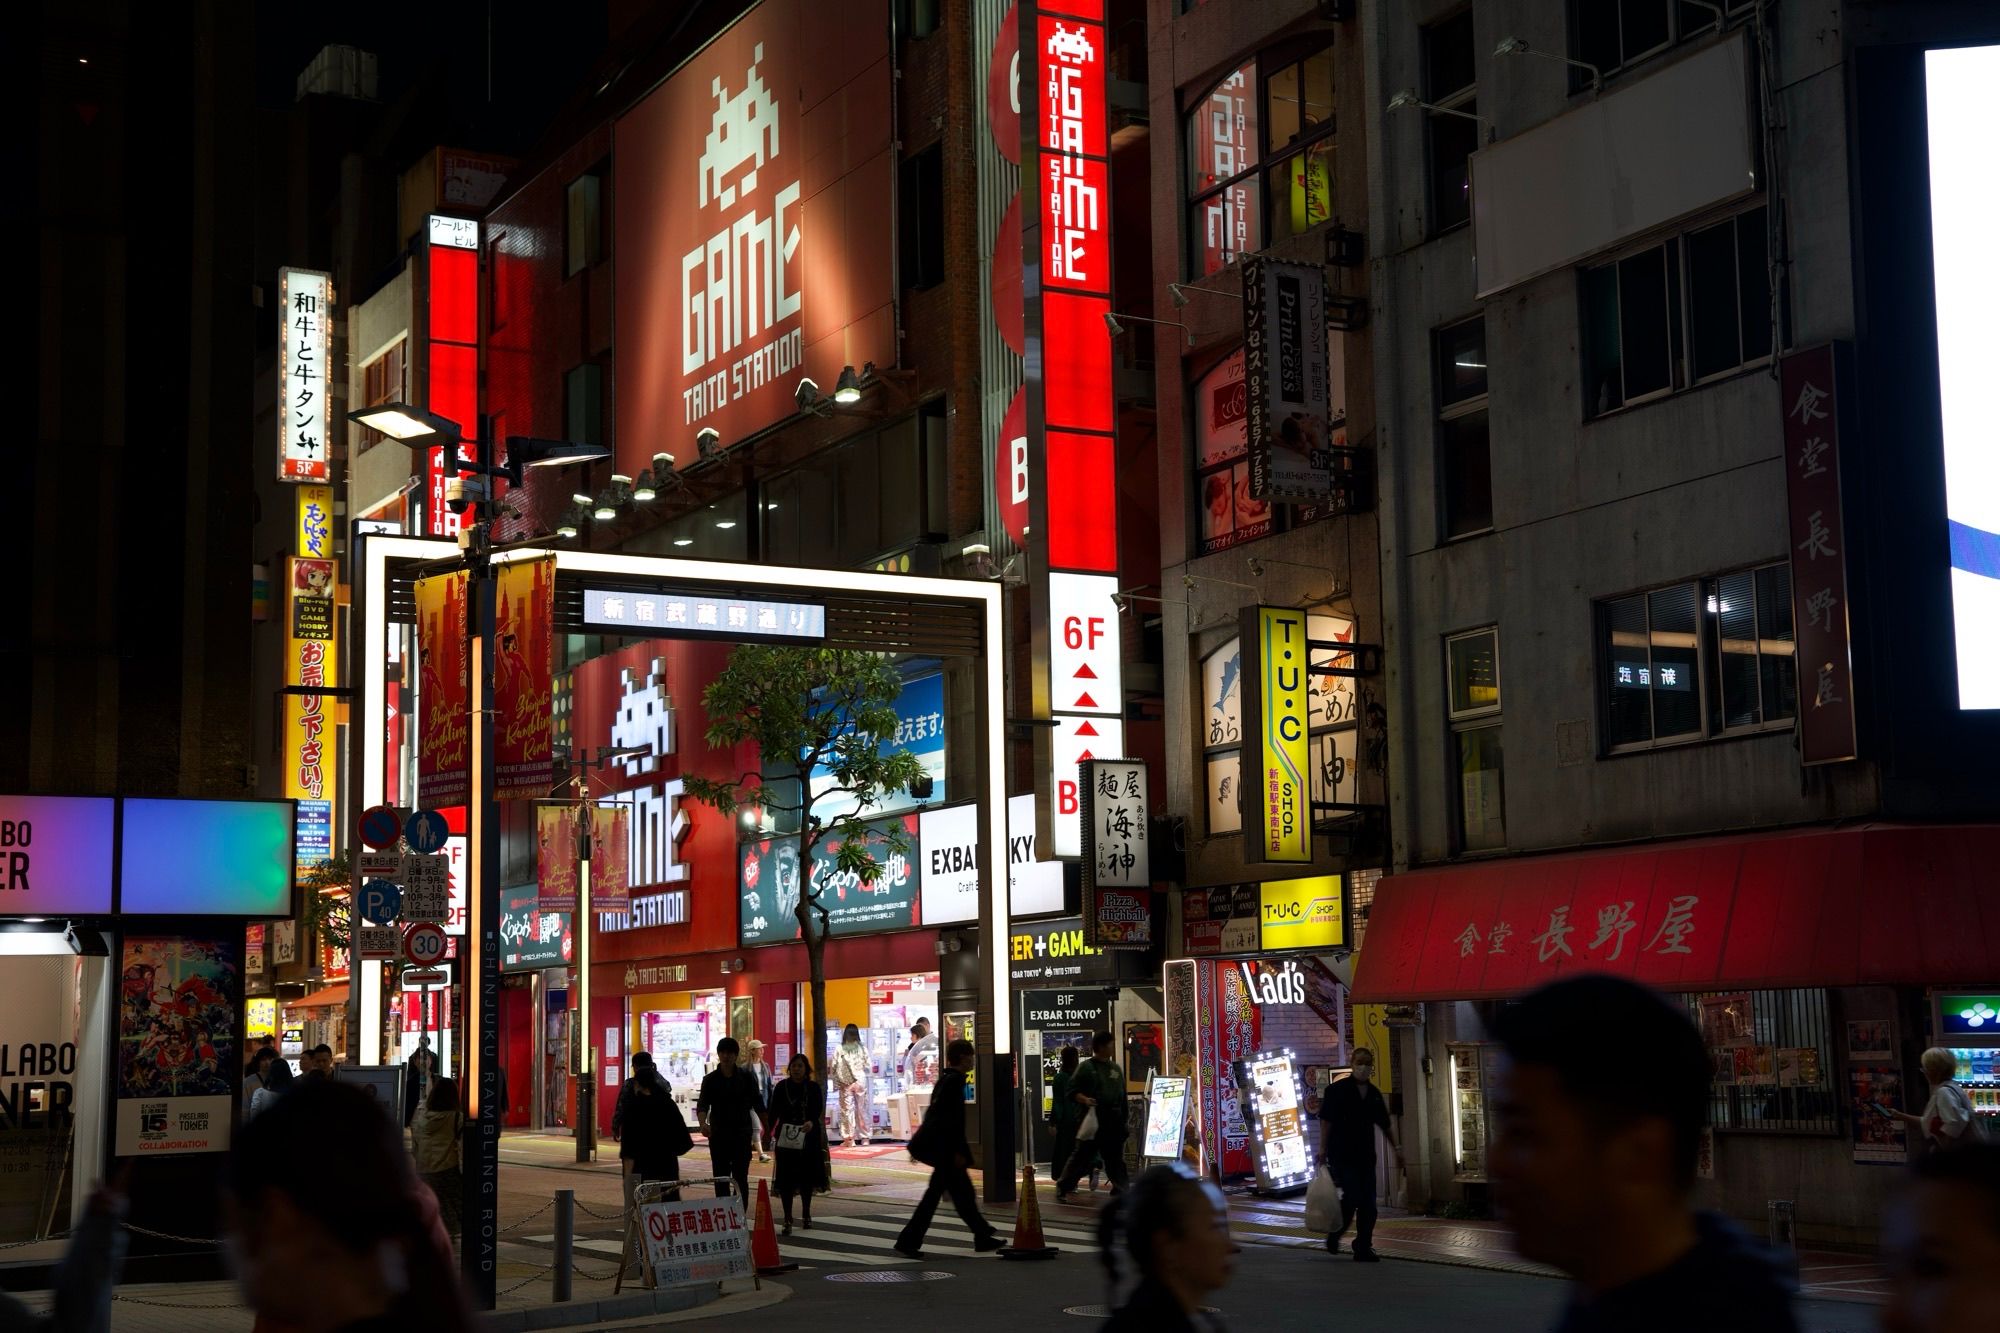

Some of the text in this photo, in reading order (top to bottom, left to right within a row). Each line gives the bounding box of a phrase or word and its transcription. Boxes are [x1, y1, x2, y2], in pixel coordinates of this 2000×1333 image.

[1049, 64, 1062, 278] TAITO STATION
[1061, 69, 1098, 281] GAME
[431, 217, 473, 233] ワールド
[455, 234, 477, 248] ビル
[682, 180, 800, 377] GAME
[1279, 288, 1297, 393] Princess
[1308, 283, 1323, 402] リフレッシュ 新宿店
[293, 291, 317, 429] 和牛と牛タン
[683, 327, 801, 426] TAITO STATION
[1245, 261, 1264, 497] プリンセス 03-6457-7557
[296, 460, 315, 475] 5F
[1312, 450, 1329, 469] 3F
[308, 489, 324, 501] 4F
[434, 473, 443, 535] TAITO
[1237, 522, 1271, 542] フェイシャル
[299, 598, 329, 606] Blu-ray
[603, 597, 805, 633] 新宿武蔵野通り
[301, 614, 327, 622] GAME
[1063, 616, 1105, 651] 6F
[298, 631, 330, 639] フィギュア
[436, 741, 463, 772] Road
[523, 737, 549, 763] Road
[1098, 768, 1142, 800] 麺屋
[1136, 804, 1144, 840] あら炊き
[1268, 767, 1281, 853] 新宿駅東南口店
[1282, 782, 1294, 838] SHOP
[1106, 805, 1135, 881] 海神
[1098, 843, 1106, 878] らーめん
[367, 891, 384, 918] P
[379, 906, 392, 919] 40
[633, 891, 685, 926] STATION
[1101, 908, 1145, 923] Highball
[1104, 893, 1134, 907] Pizza
[1316, 905, 1334, 914] SHOP
[1453, 895, 1699, 962] 食堂 長野屋
[414, 935, 439, 954] 30
[639, 964, 687, 985] TAITO STATION
[1242, 961, 1305, 1004] Lad's
[1030, 1010, 1063, 1020] EXBAR
[1057, 994, 1075, 1006] B1F
[179, 1112, 209, 1121] PASELABO
[481, 941, 496, 1273] SHINJUKU RAMBLING ROAD
[179, 1119, 209, 1131] TOWER
[138, 1140, 209, 1151] COLLABORATION
[667, 1206, 741, 1237] 車両通行止
